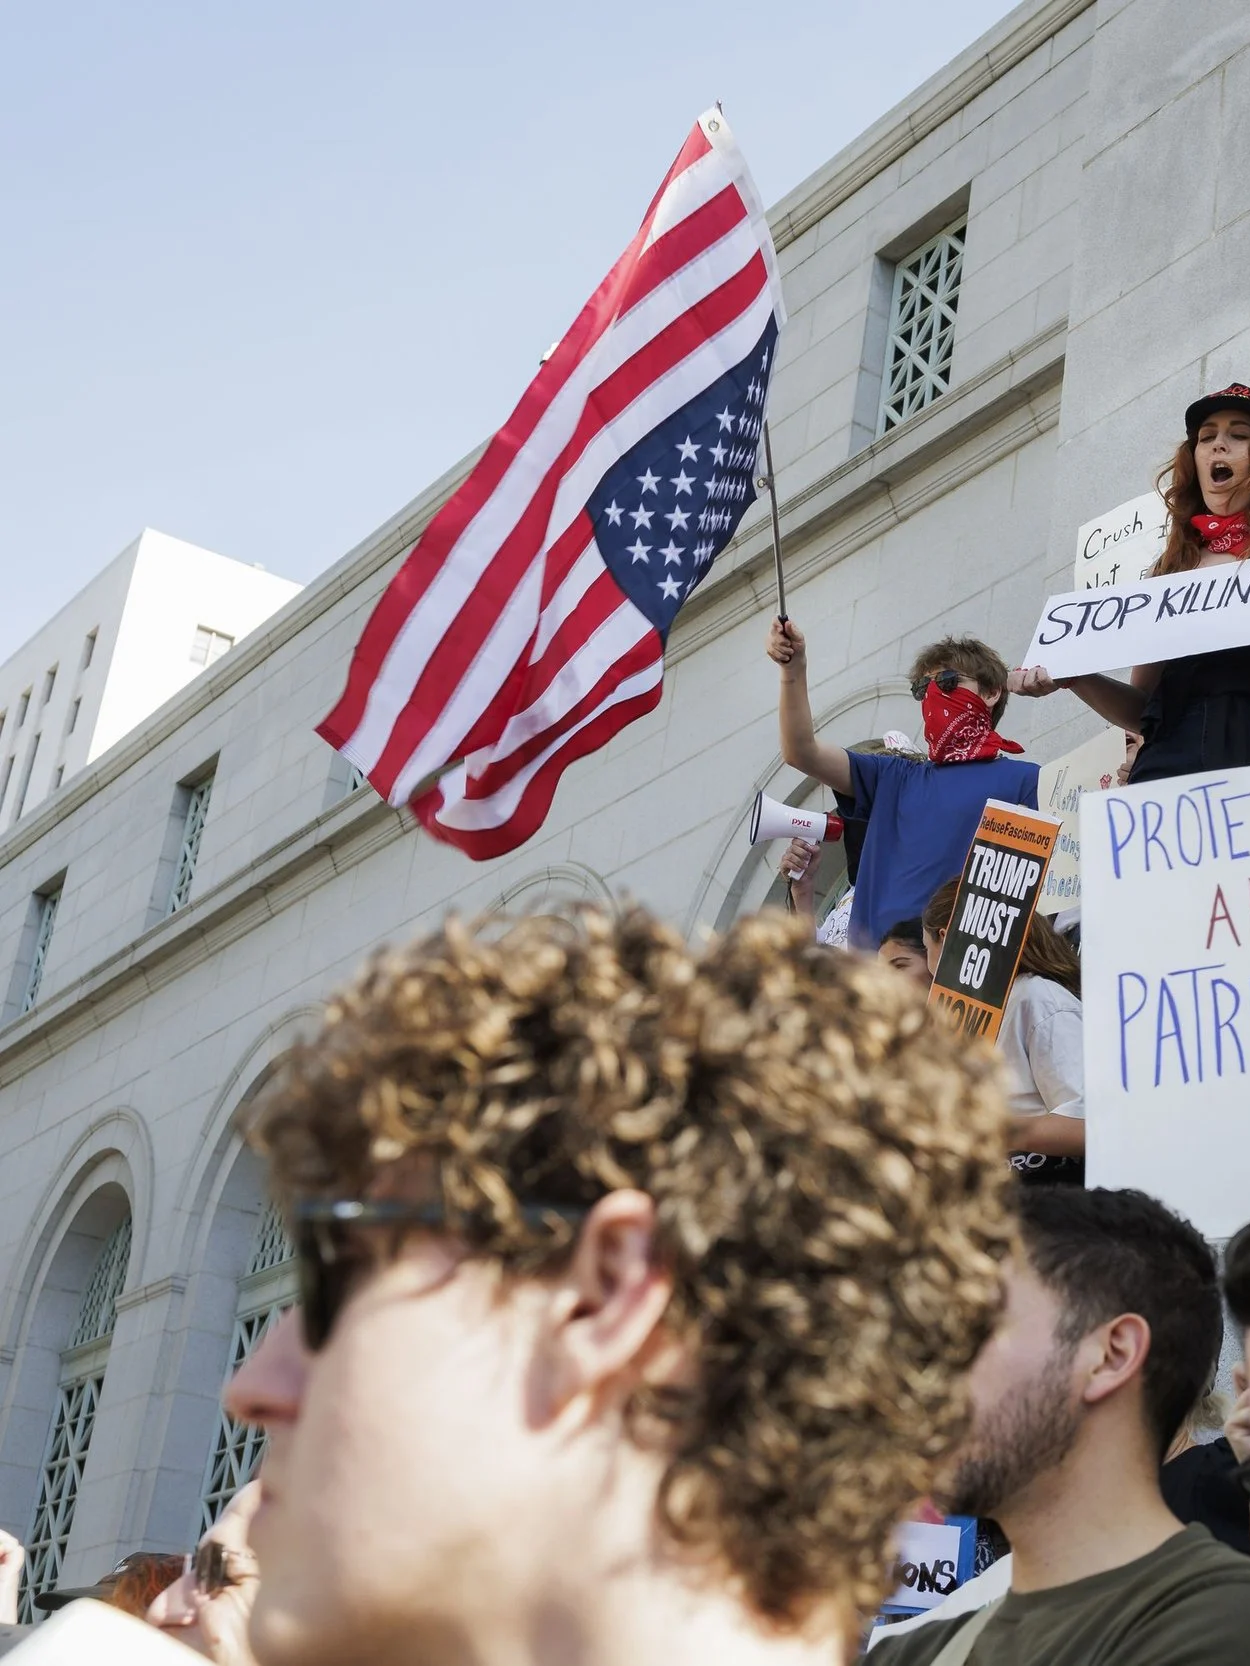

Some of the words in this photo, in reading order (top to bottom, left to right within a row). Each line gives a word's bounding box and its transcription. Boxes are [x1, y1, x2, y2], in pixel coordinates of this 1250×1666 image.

[1083, 511, 1143, 560] Crush
[1038, 593, 1152, 646] STOP
[791, 818, 812, 828] PYLE
[979, 815, 1051, 850] RefuseFascism.org
[968, 844, 1040, 901] TRUMP
[958, 892, 1021, 947] MUST
[959, 943, 991, 990] GO
